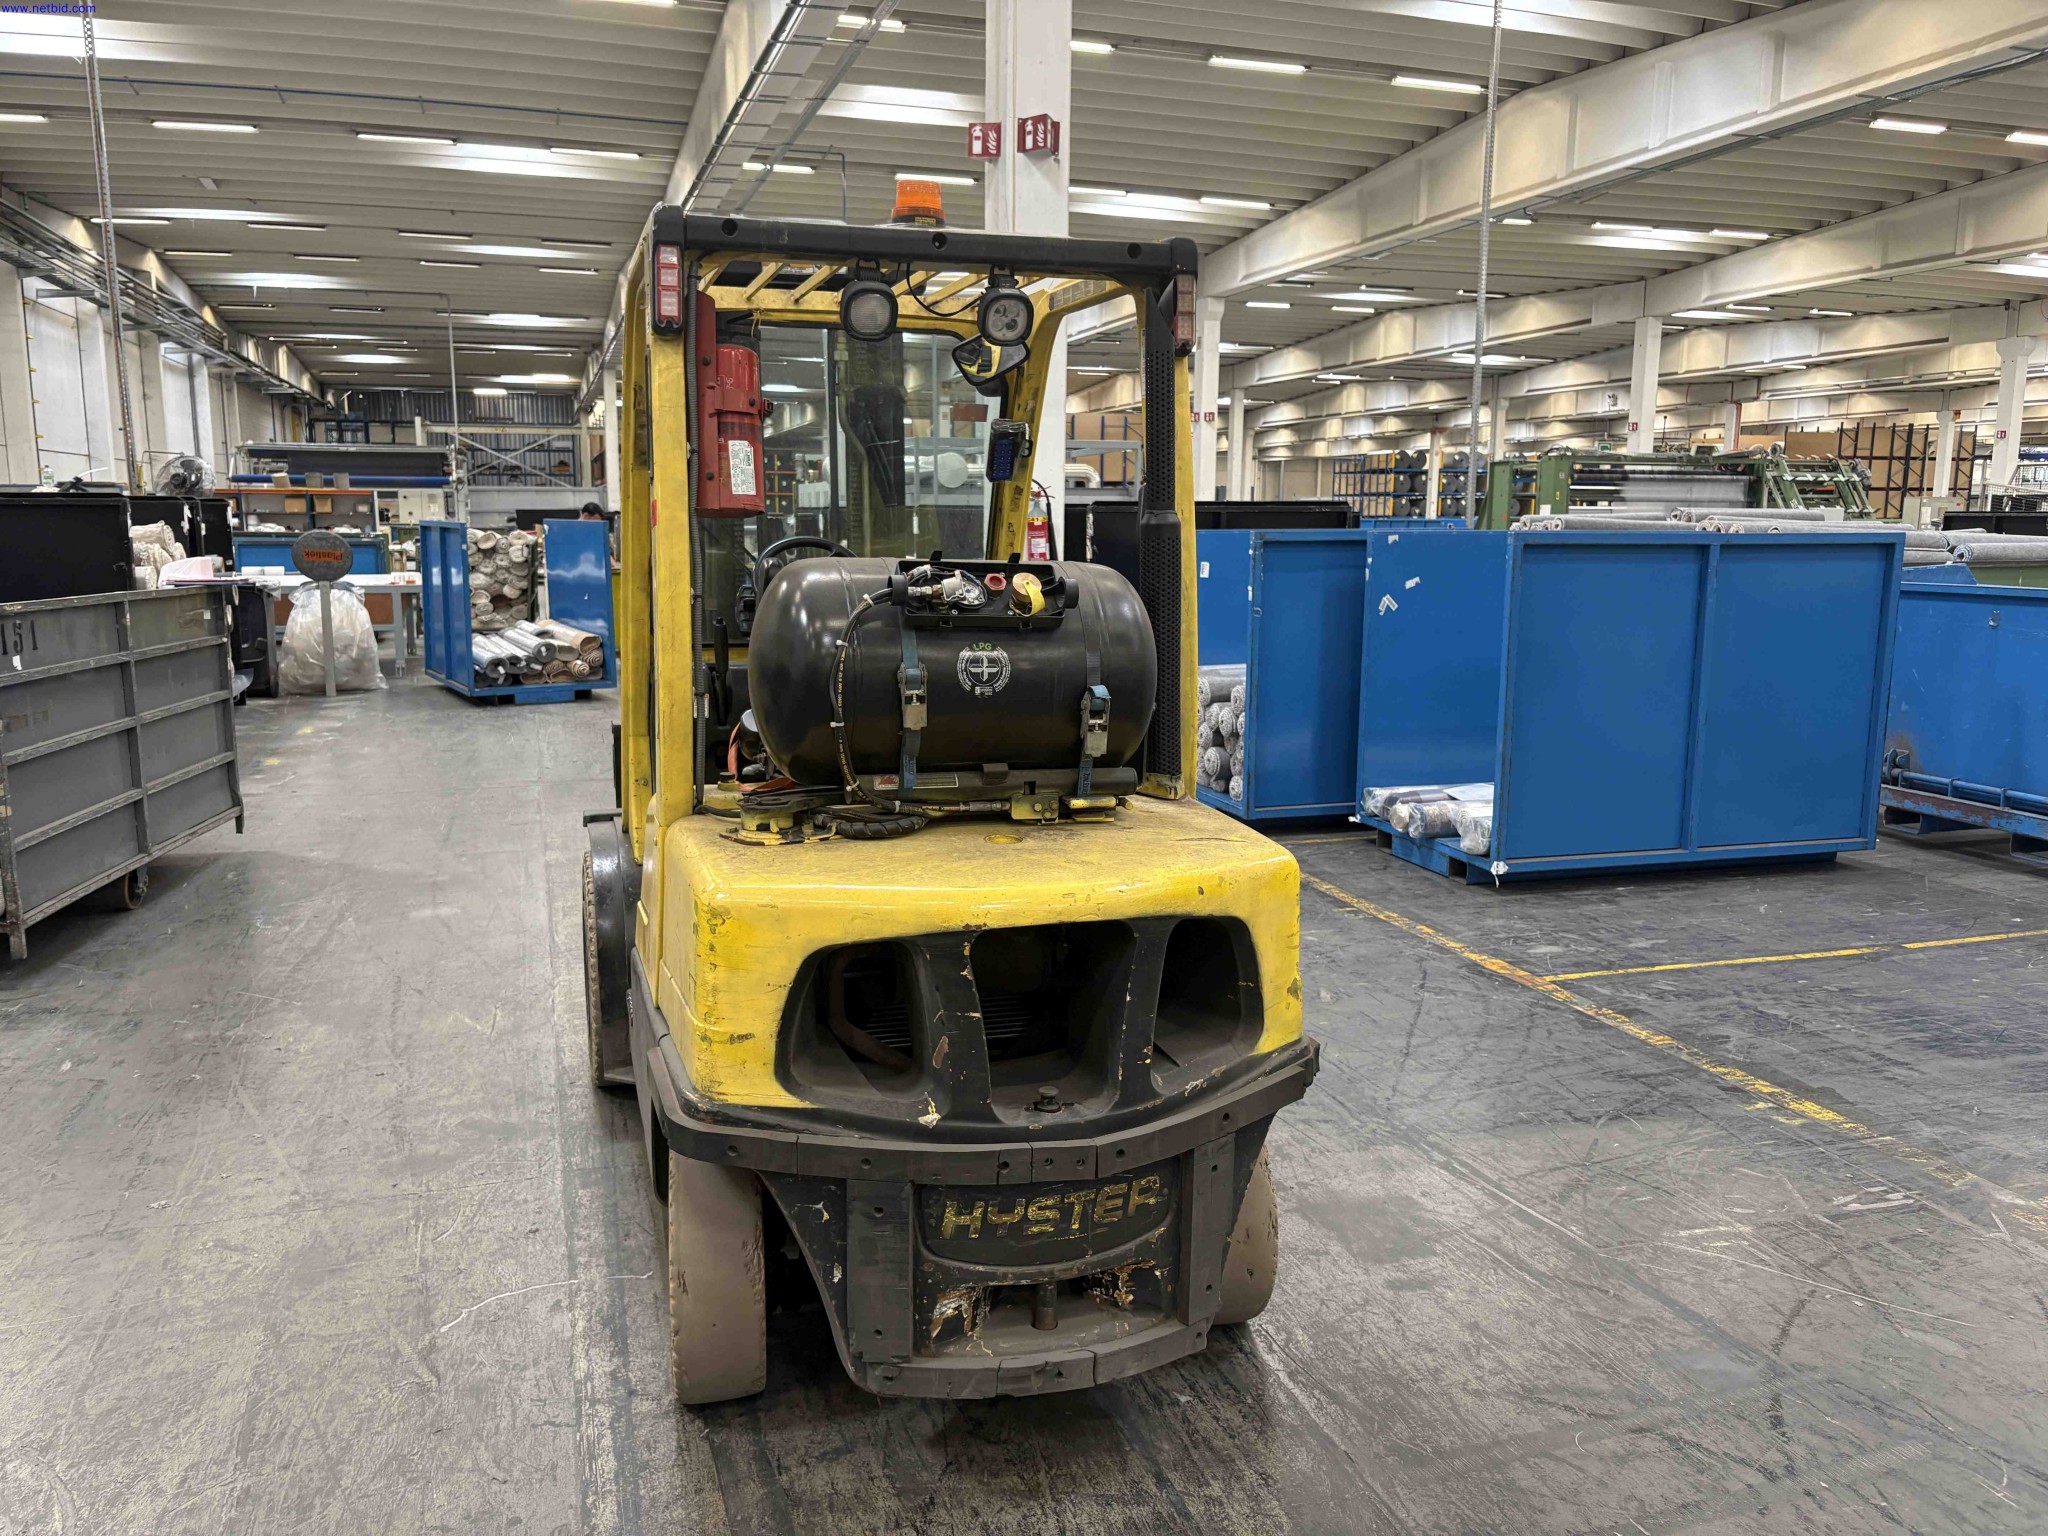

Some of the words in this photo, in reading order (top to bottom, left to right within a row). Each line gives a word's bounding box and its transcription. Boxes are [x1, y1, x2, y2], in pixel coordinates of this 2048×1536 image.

[304, 550, 343, 561] Plastiek
[972, 642, 992, 650] LPG
[939, 1174, 1161, 1240] HYSTER
